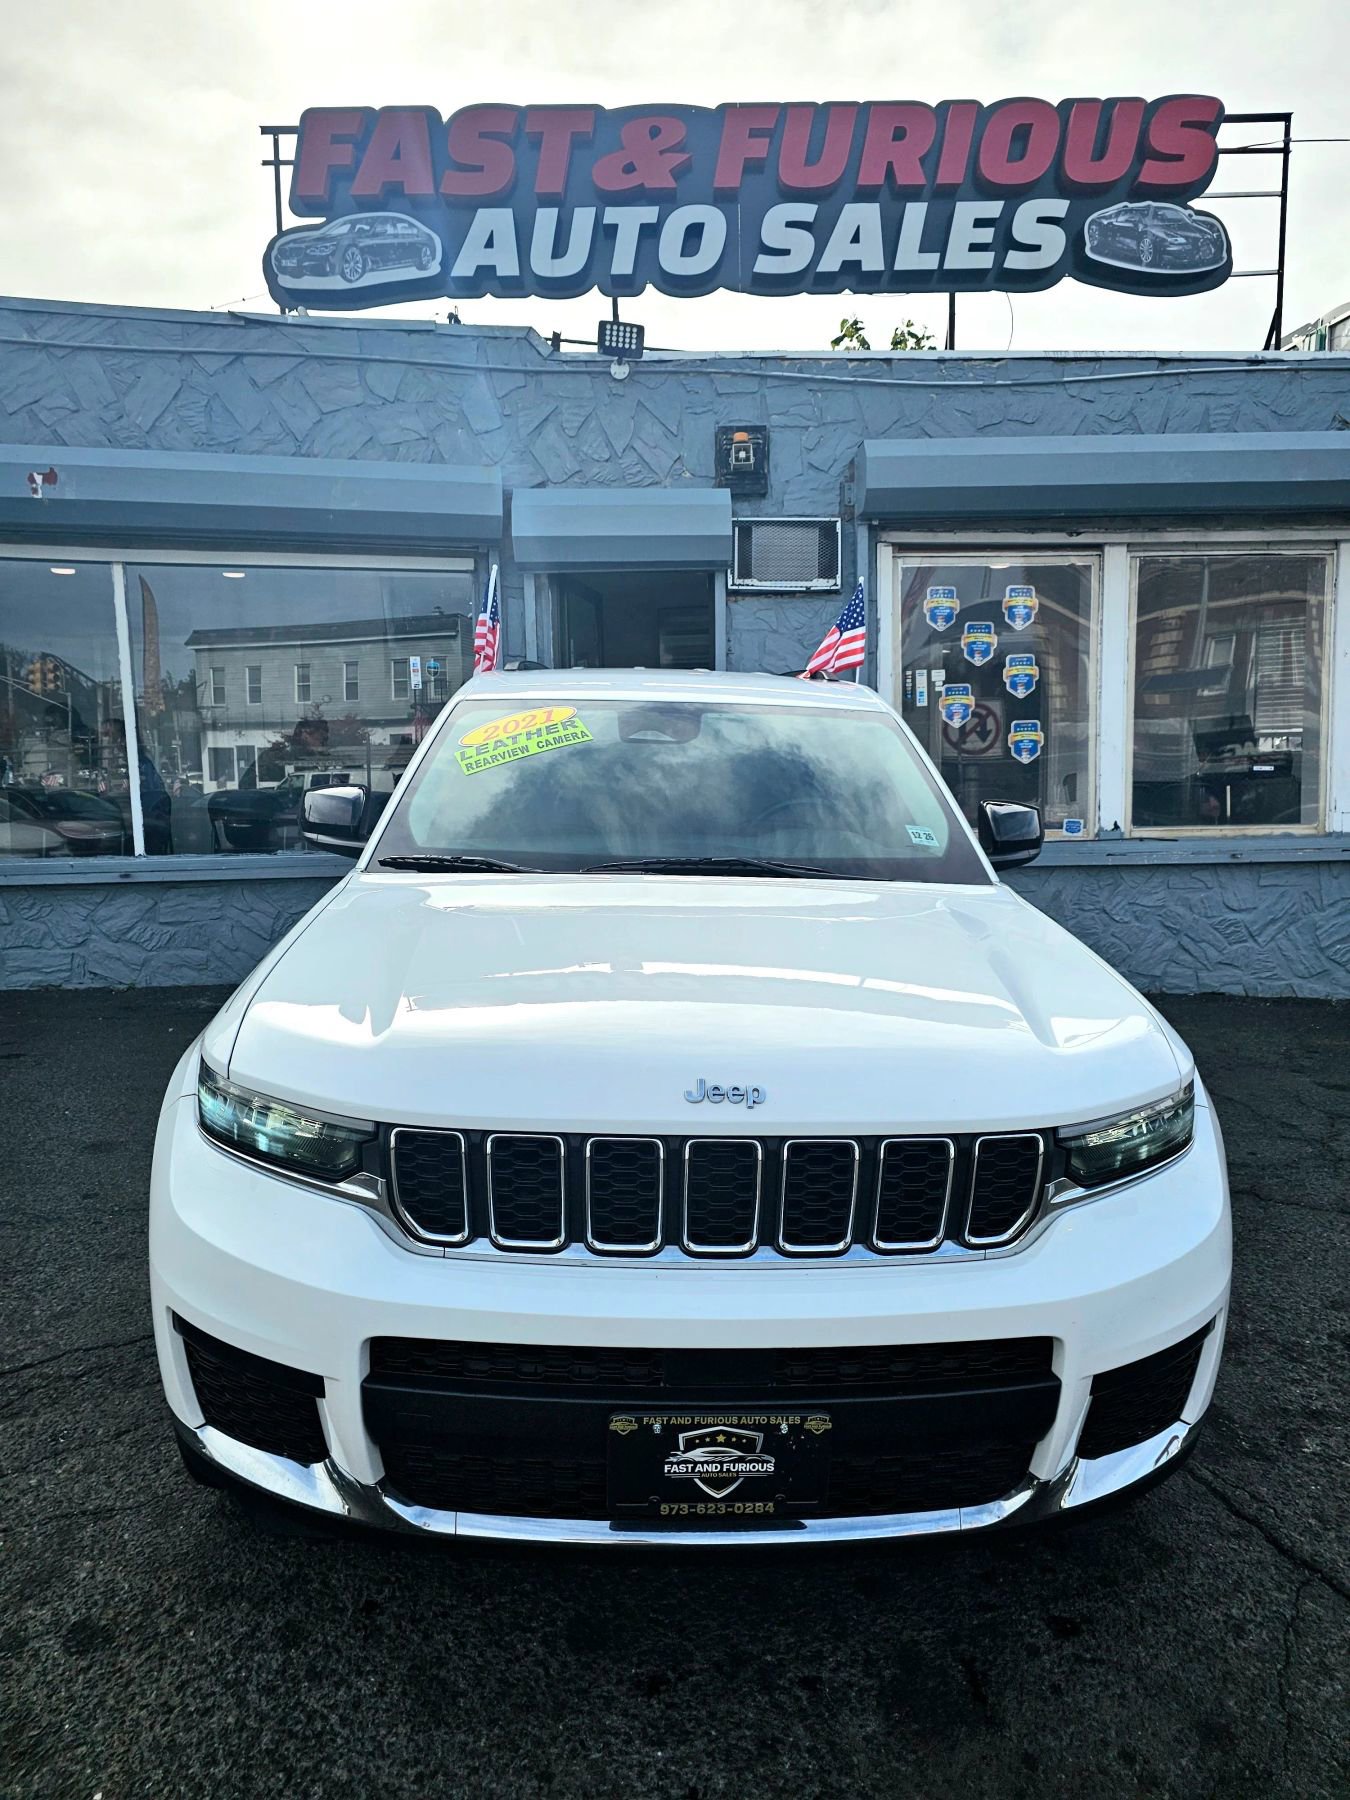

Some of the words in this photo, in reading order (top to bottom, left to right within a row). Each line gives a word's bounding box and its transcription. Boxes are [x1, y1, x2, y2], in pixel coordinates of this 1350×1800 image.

[296, 108, 596, 199] FAST
[592, 116, 692, 194] &
[713, 101, 1220, 189] FURIOUS
[451, 204, 727, 278] AUTO
[753, 198, 1071, 273] SALES
[460, 719, 579, 762] LEATHER
[483, 709, 555, 742] 2021
[464, 744, 530, 772] REARVIEW
[536, 730, 589, 750] CAMERA
[684, 1078, 767, 1109] Jeep
[643, 1416, 668, 1425] FAST
[670, 1416, 692, 1425] AND
[694, 1416, 738, 1425] FURIOUS
[740, 1416, 768, 1425] AUTO
[769, 1415, 801, 1425] SALES
[664, 1463, 694, 1473] FAST
[695, 1463, 720, 1472] AND
[722, 1462, 775, 1472] FURIOUS
[660, 1503, 775, 1515] 973-623-0284
